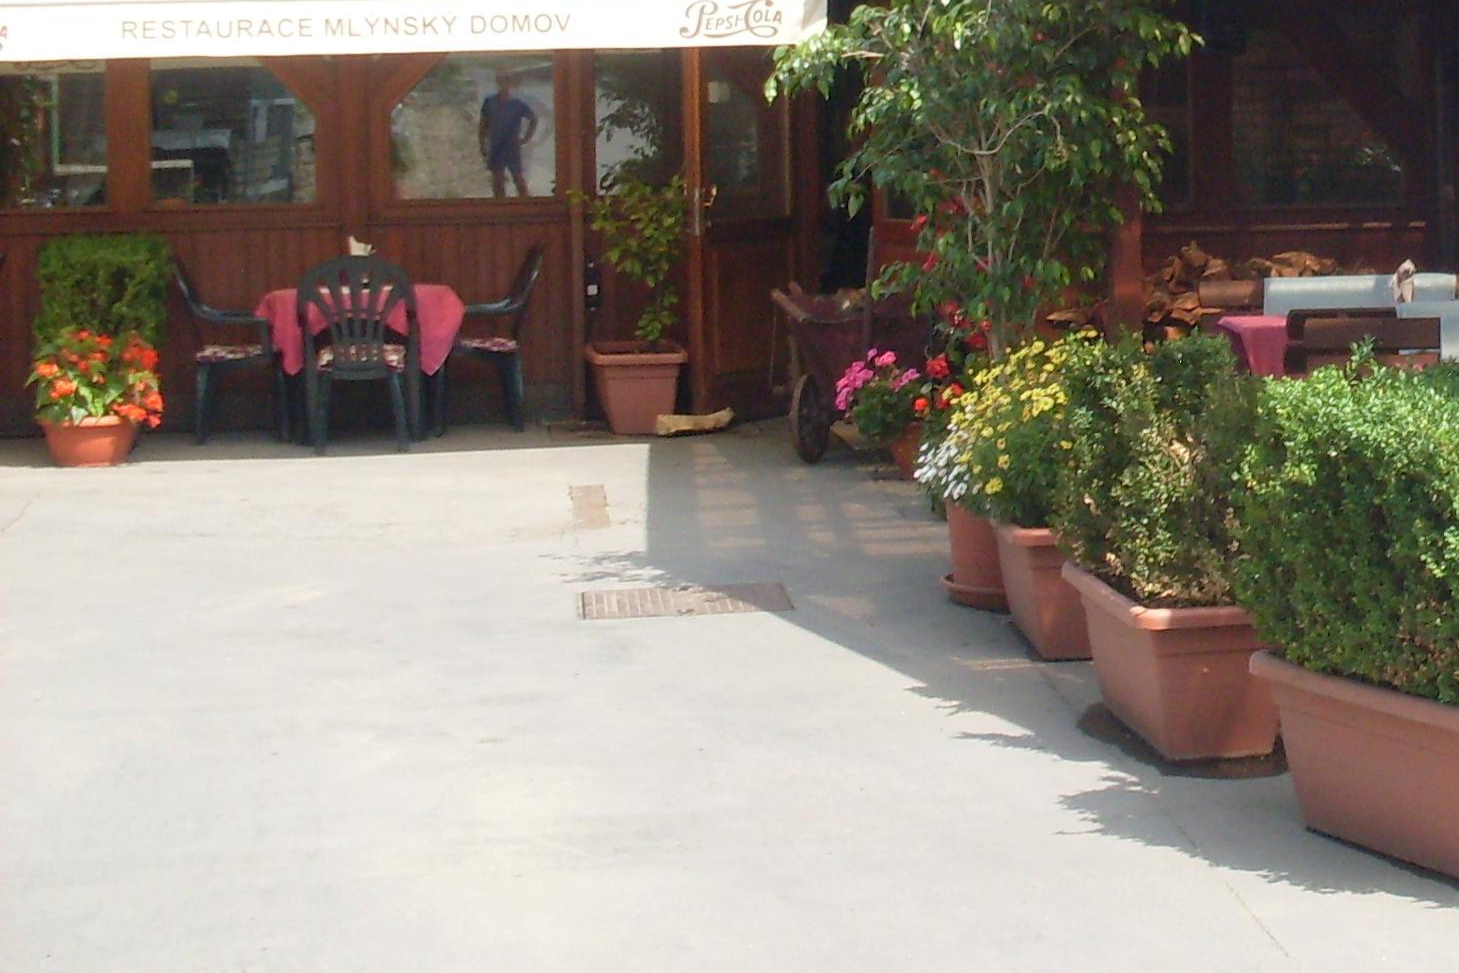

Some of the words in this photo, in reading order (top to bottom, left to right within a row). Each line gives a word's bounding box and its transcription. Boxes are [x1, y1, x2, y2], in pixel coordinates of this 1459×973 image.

[121, 17, 313, 39] RESTAURACE
[324, 10, 457, 37] MLÝNSKÝ
[471, 13, 571, 34] DOMOV
